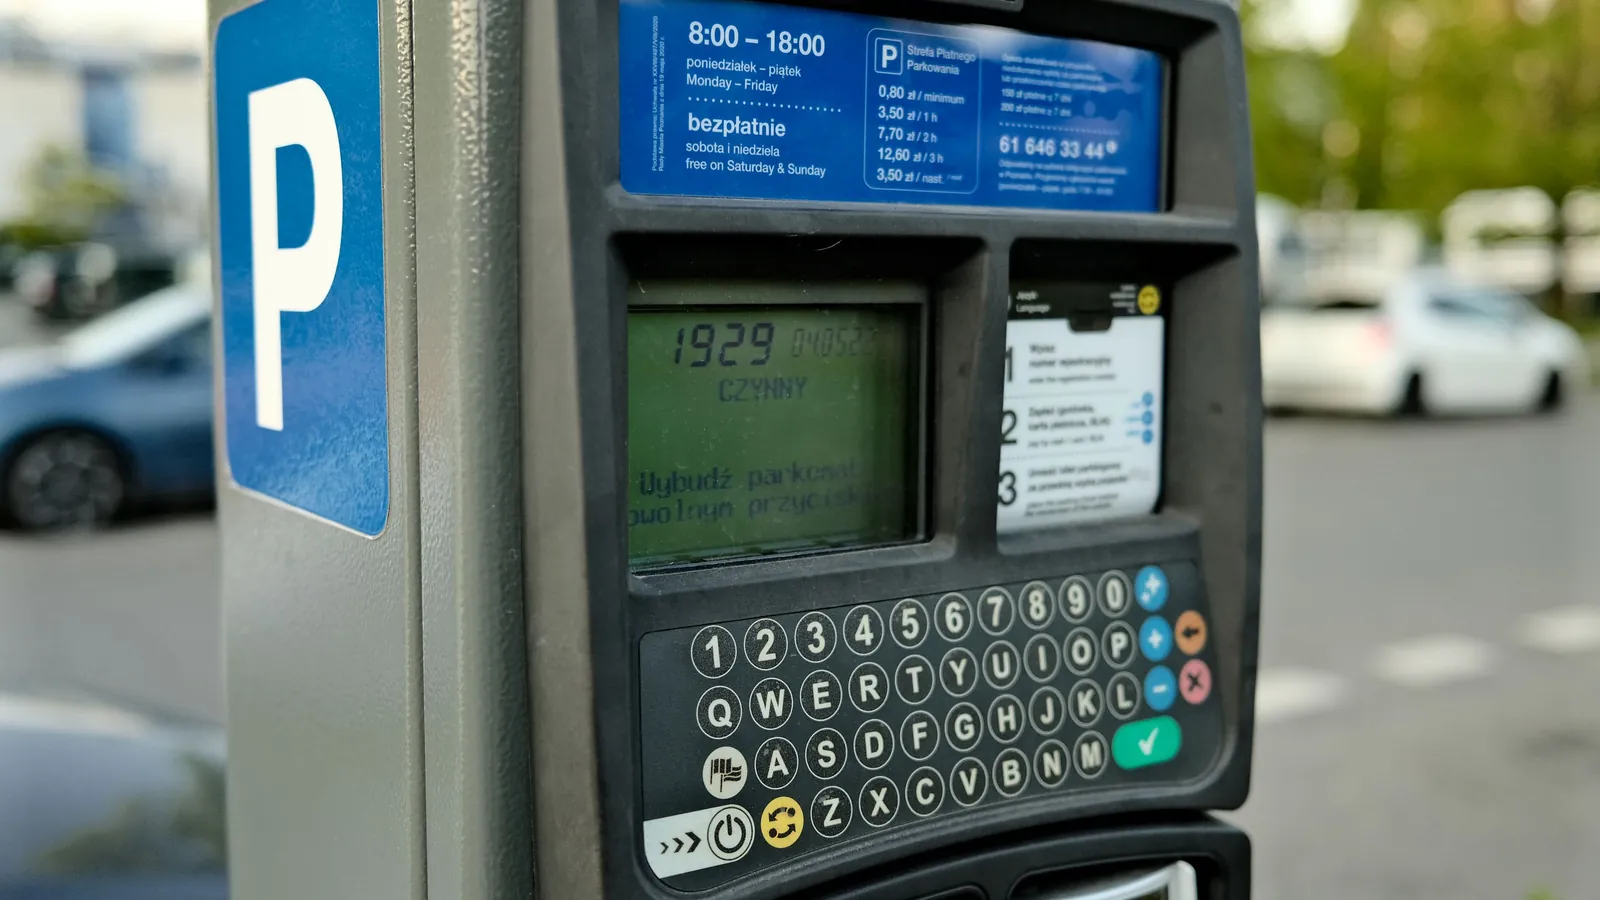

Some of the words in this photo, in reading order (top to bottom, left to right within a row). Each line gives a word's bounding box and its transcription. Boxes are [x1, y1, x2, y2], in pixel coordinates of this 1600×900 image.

[688, 21, 739, 48] 8:00
[766, 30, 825, 57] 18:00
[882, 44, 898, 69] P
[907, 45, 935, 58] Strefa
[936, 48, 977, 64] Płatnego
[686, 57, 757, 73] poniedziałek
[769, 64, 801, 78] piątek
[907, 60, 960, 75] Parkowania
[686, 73, 732, 91] Monday
[744, 78, 778, 95] Friday
[878, 84, 905, 100] 0,80
[907, 90, 916, 101] zł
[924, 92, 966, 105] minimum
[688, 112, 786, 137] bezpłatnie
[878, 105, 904, 121] 3,50
[906, 110, 916, 121] zł
[923, 112, 929, 122] 1
[931, 112, 938, 122] h
[877, 126, 904, 142] 7,70
[906, 131, 915, 142] zł
[923, 132, 929, 143] 2
[930, 132, 938, 143] h
[686, 141, 724, 154] sobota
[727, 143, 731, 154] i
[733, 143, 780, 157] niedziela
[877, 147, 910, 163] 12,60
[913, 152, 922, 163] zł
[999, 135, 1019, 154] 61
[1025, 136, 1056, 157] 646
[1060, 139, 1080, 159] 33
[1084, 141, 1104, 160] 44
[685, 158, 707, 170] free
[710, 160, 724, 170] on
[727, 159, 774, 176] Saturday
[777, 163, 785, 174] &
[787, 163, 826, 179] Sunday
[877, 168, 903, 183] 3,50
[905, 172, 914, 182] zł
[248, 77, 344, 432] P
[674, 322, 775, 367] 1929
[718, 376, 809, 403] CZYNNY
[1001, 409, 1018, 446] 2
[640, 467, 733, 498] Wybudź
[998, 471, 1018, 507] 3
[705, 635, 721, 669] 1
[756, 628, 776, 662] 2
[807, 621, 826, 653] 3
[855, 614, 874, 646] 4
[901, 608, 919, 640] 5
[945, 602, 964, 633] 6
[987, 595, 1003, 627] 7
[1028, 590, 1046, 621] 8
[1067, 584, 1085, 616] 9
[1106, 579, 1124, 609] 0
[708, 699, 732, 728] Q
[757, 689, 785, 719] W
[812, 682, 832, 710] E
[859, 674, 880, 702] R
[906, 666, 923, 693] T
[950, 658, 967, 685] Y
[992, 651, 1010, 679] U
[1038, 645, 1046, 671] I
[1071, 638, 1092, 665] O
[1111, 631, 1128, 659] P
[767, 750, 789, 779] A
[817, 740, 836, 768] S
[864, 731, 884, 759] D
[912, 721, 927, 749] F
[954, 713, 975, 740] G
[997, 705, 1017, 732] H
[1040, 697, 1054, 724] J
[1077, 689, 1096, 717] K
[1116, 683, 1133, 709] L
[823, 798, 841, 827] Z
[869, 787, 890, 817] X
[916, 777, 935, 805] C
[959, 768, 977, 796] V
[1003, 759, 1021, 787] B
[1043, 750, 1062, 778] N
[1081, 740, 1101, 769] M
